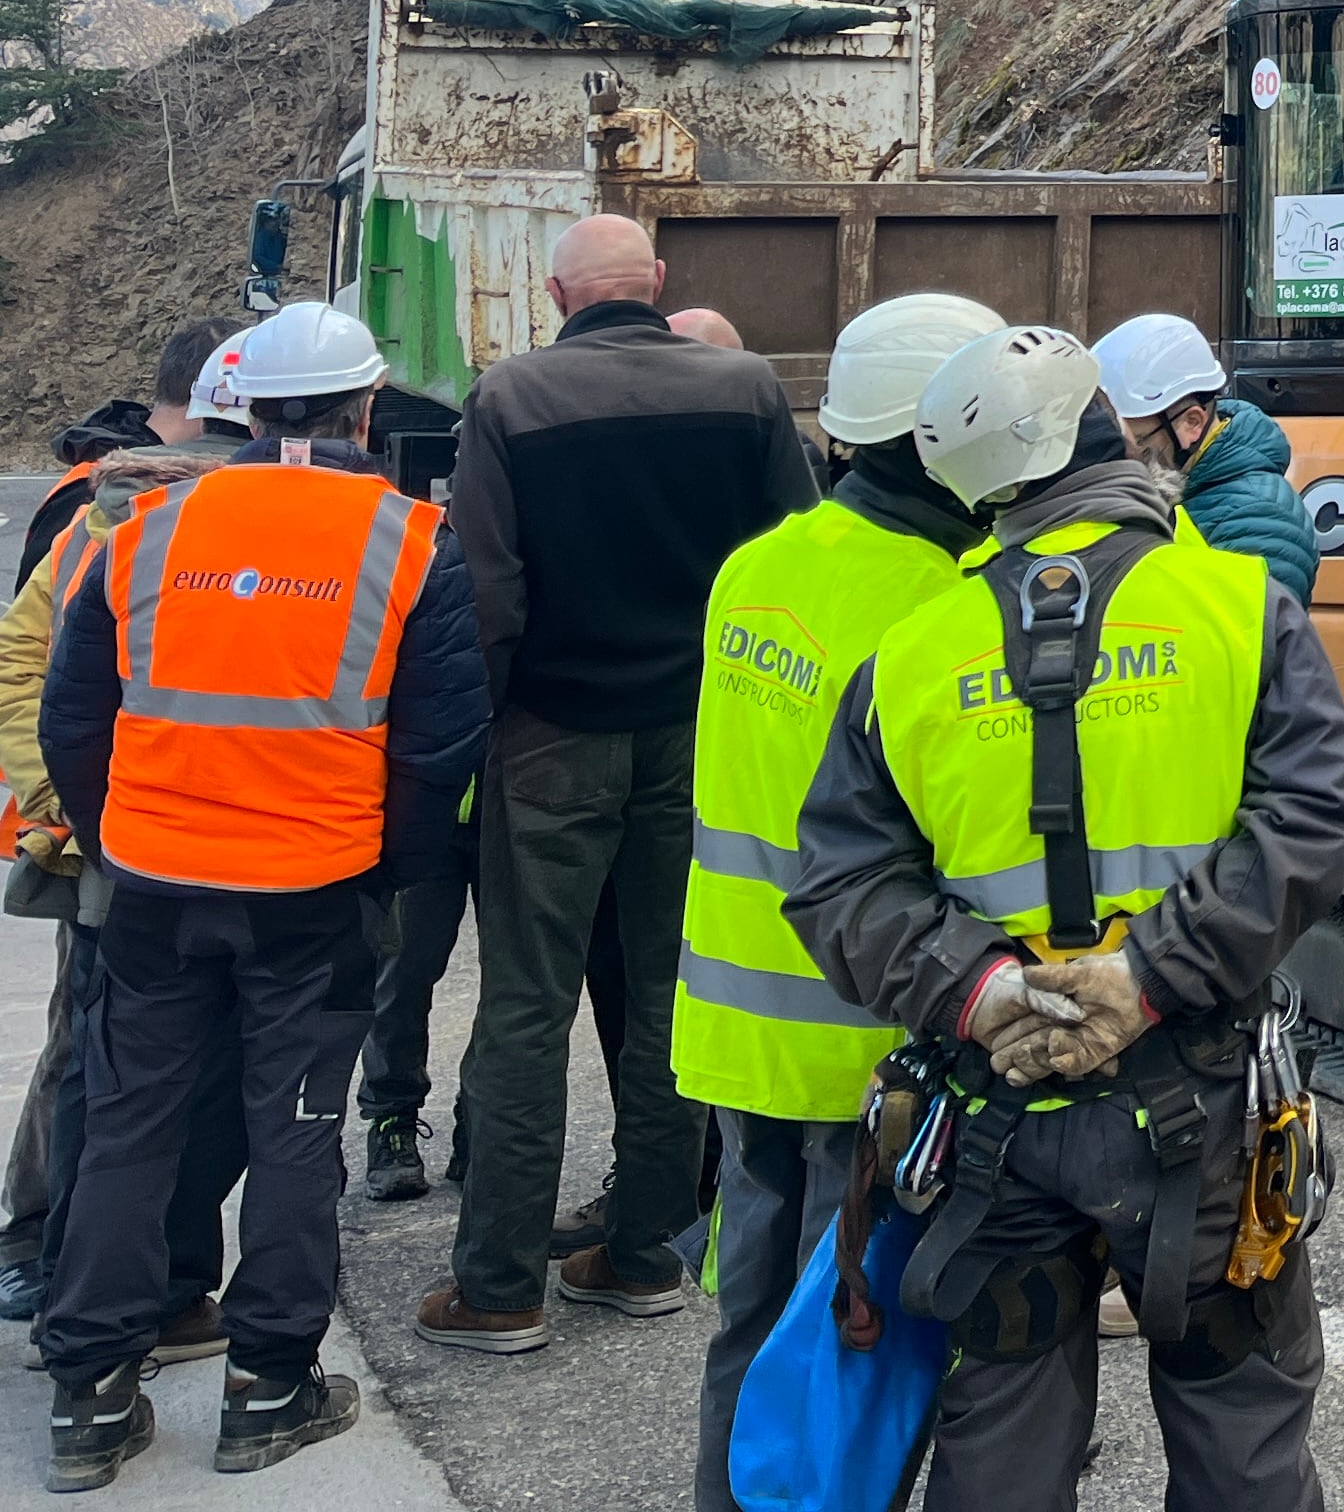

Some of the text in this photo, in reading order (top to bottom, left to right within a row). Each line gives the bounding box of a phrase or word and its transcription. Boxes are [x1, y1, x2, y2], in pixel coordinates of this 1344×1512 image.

[1255, 72, 1277, 95] 80
[1277, 284, 1299, 299] Tel.
[1302, 283, 1339, 299] +376
[173, 569, 343, 602] euroConsult
[718, 621, 816, 694] EDICOM
[957, 642, 1156, 711] EDOM
